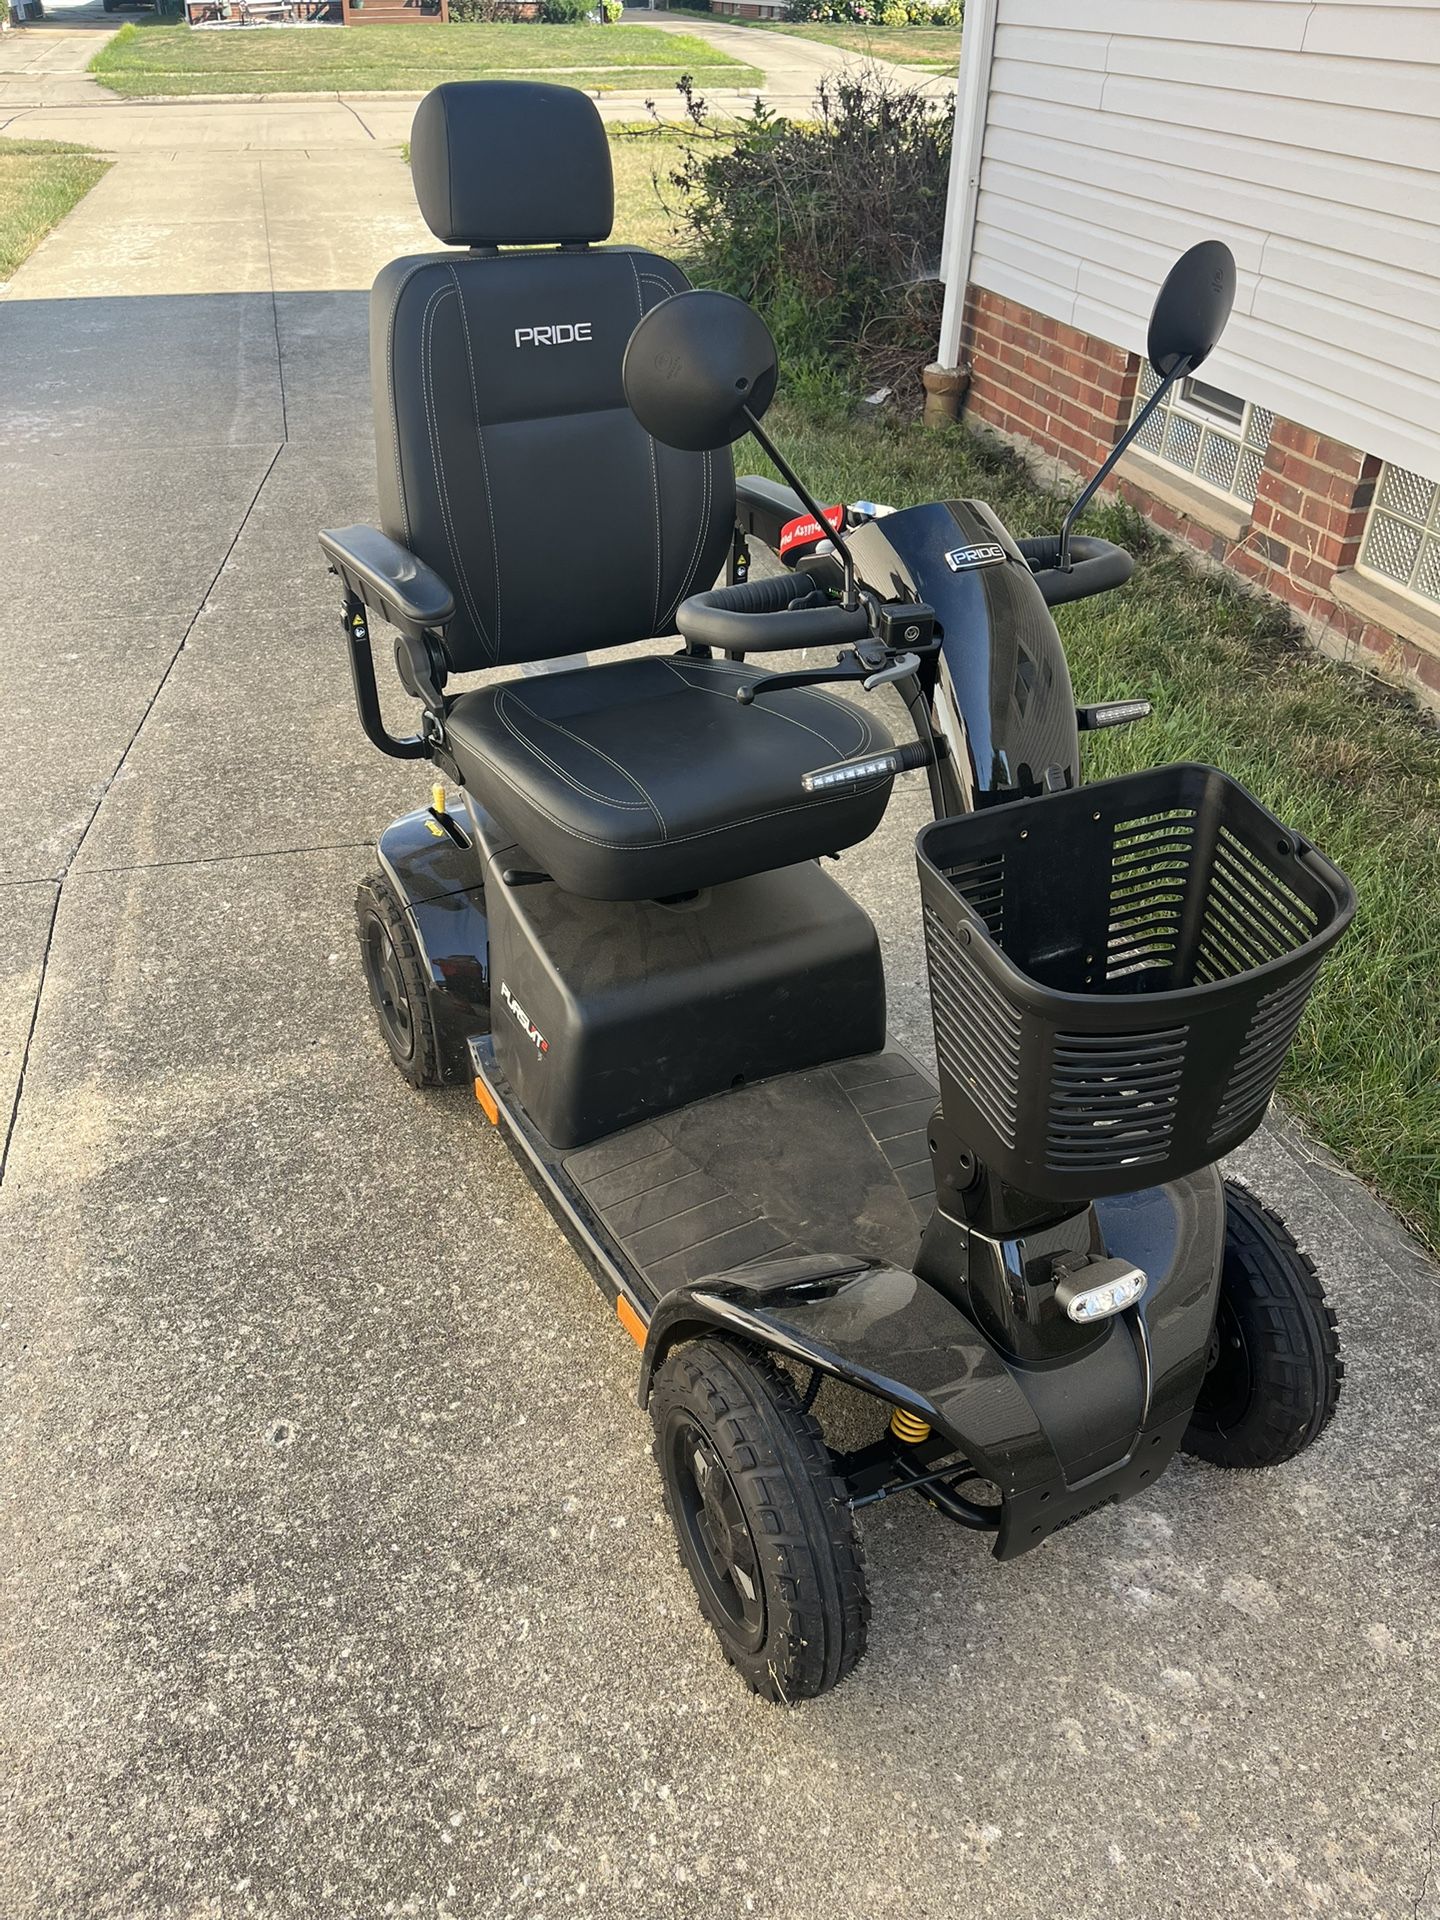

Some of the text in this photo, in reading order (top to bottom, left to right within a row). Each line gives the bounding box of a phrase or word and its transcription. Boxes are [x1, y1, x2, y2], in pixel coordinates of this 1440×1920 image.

[515, 323, 592, 347] PRIDE
[794, 516, 838, 537] Mbility
[953, 547, 1002, 564] PRIDE
